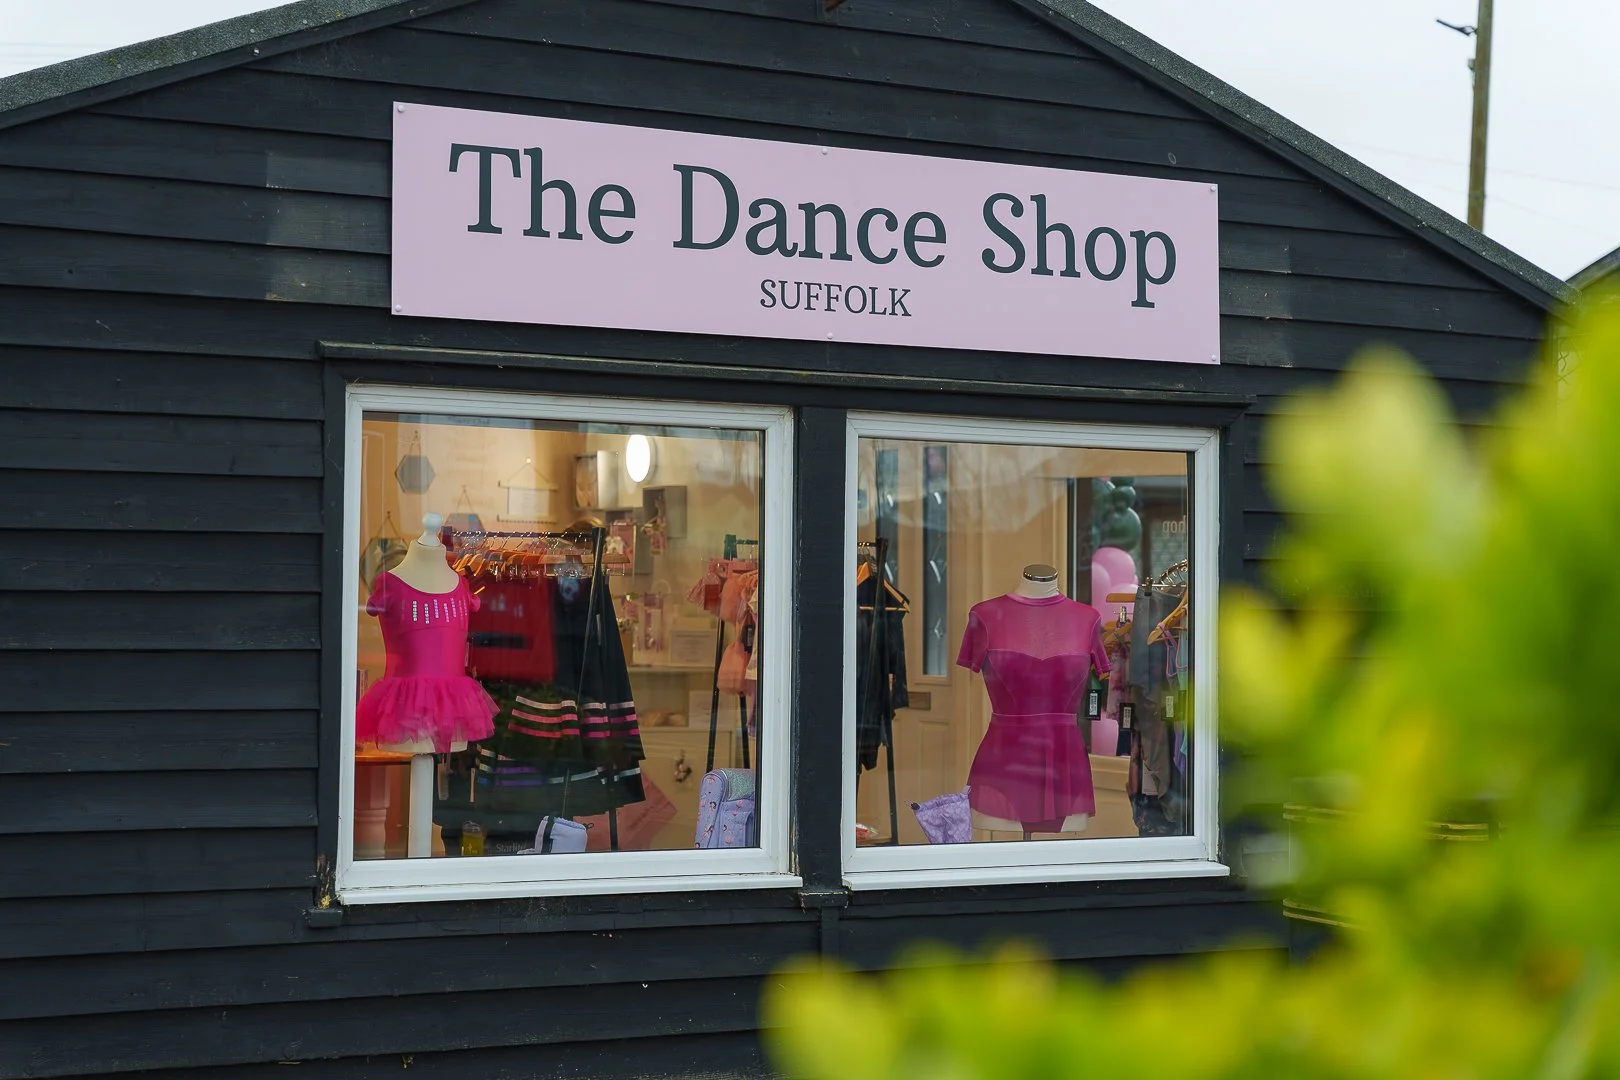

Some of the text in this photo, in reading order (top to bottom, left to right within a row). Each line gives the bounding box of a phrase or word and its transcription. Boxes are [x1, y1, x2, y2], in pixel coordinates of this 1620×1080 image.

[449, 143, 1176, 308] The Dance Shop
[760, 279, 911, 316] SUFFOLK
